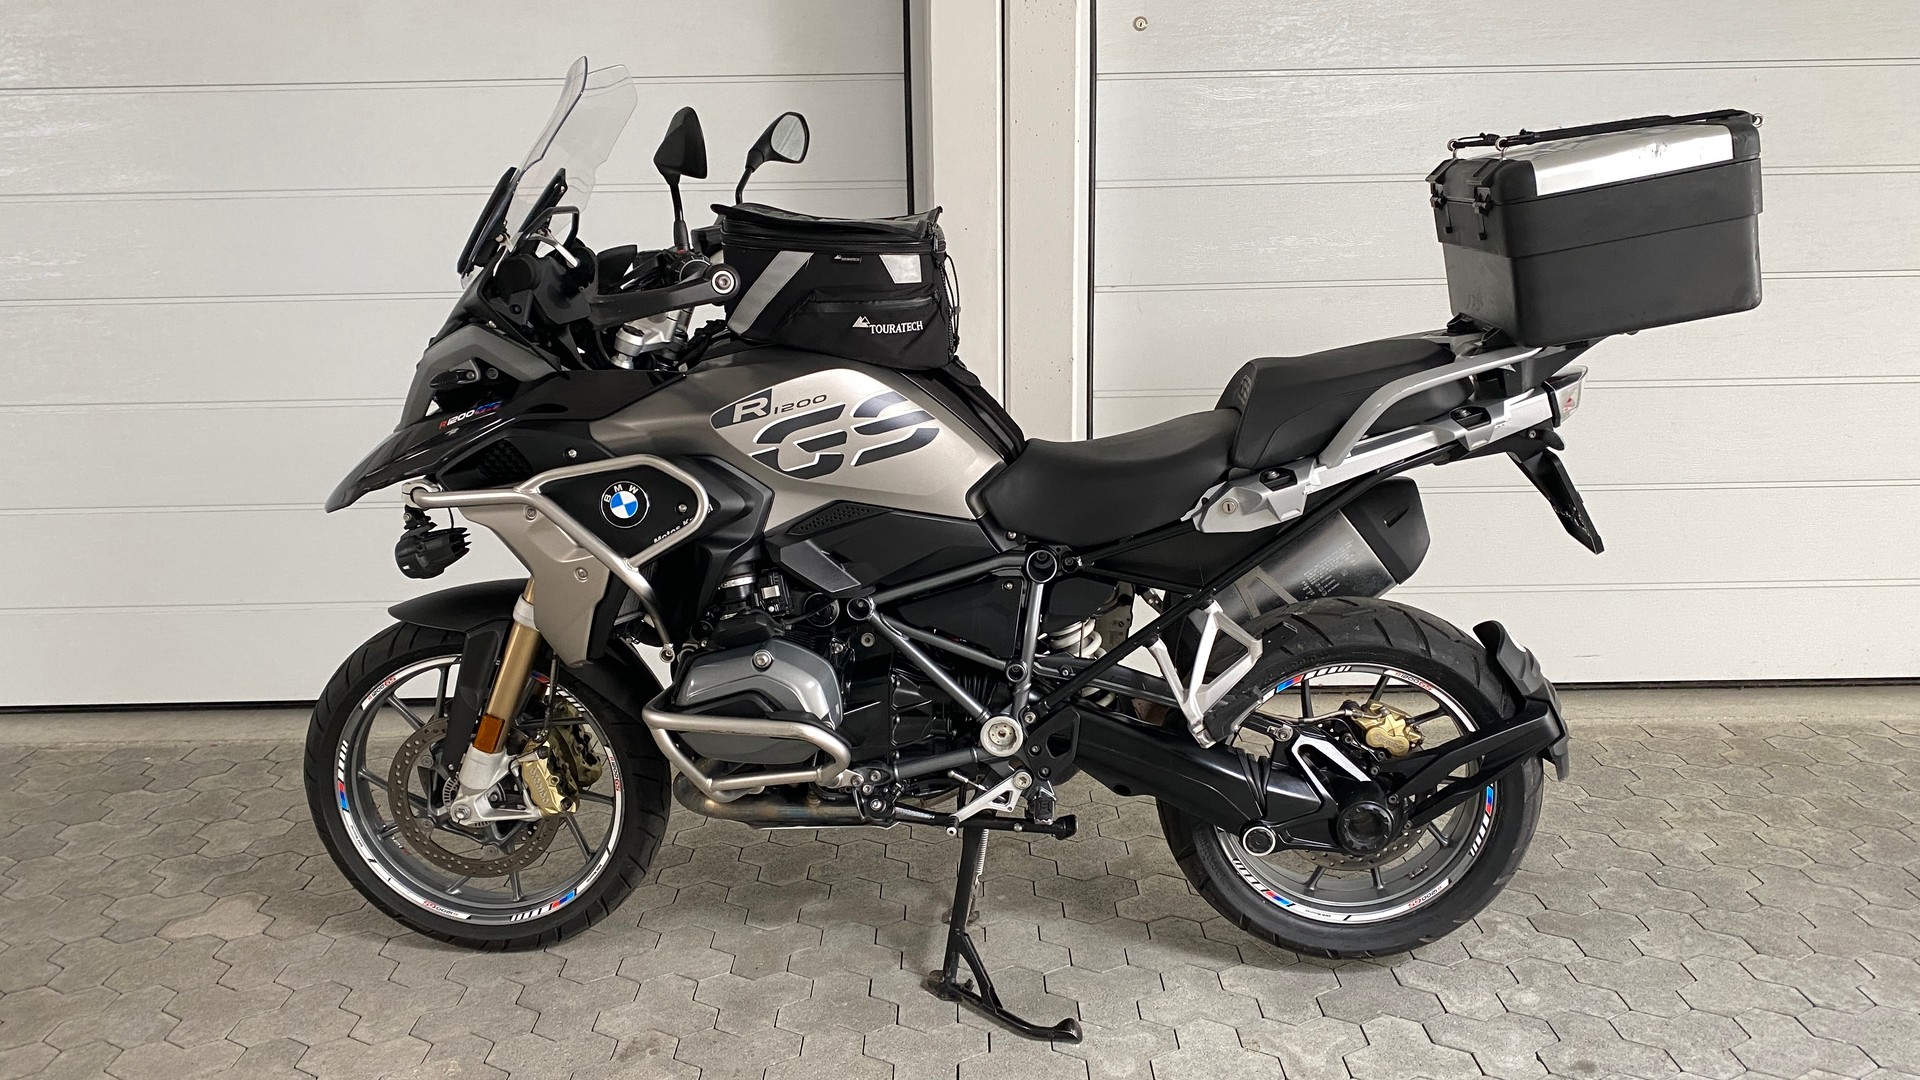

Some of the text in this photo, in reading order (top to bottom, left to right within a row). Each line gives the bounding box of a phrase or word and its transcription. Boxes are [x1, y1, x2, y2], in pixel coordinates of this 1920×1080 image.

[869, 321, 924, 334] TOURATECH
[749, 390, 940, 480] GS
[604, 483, 639, 503] BMW
